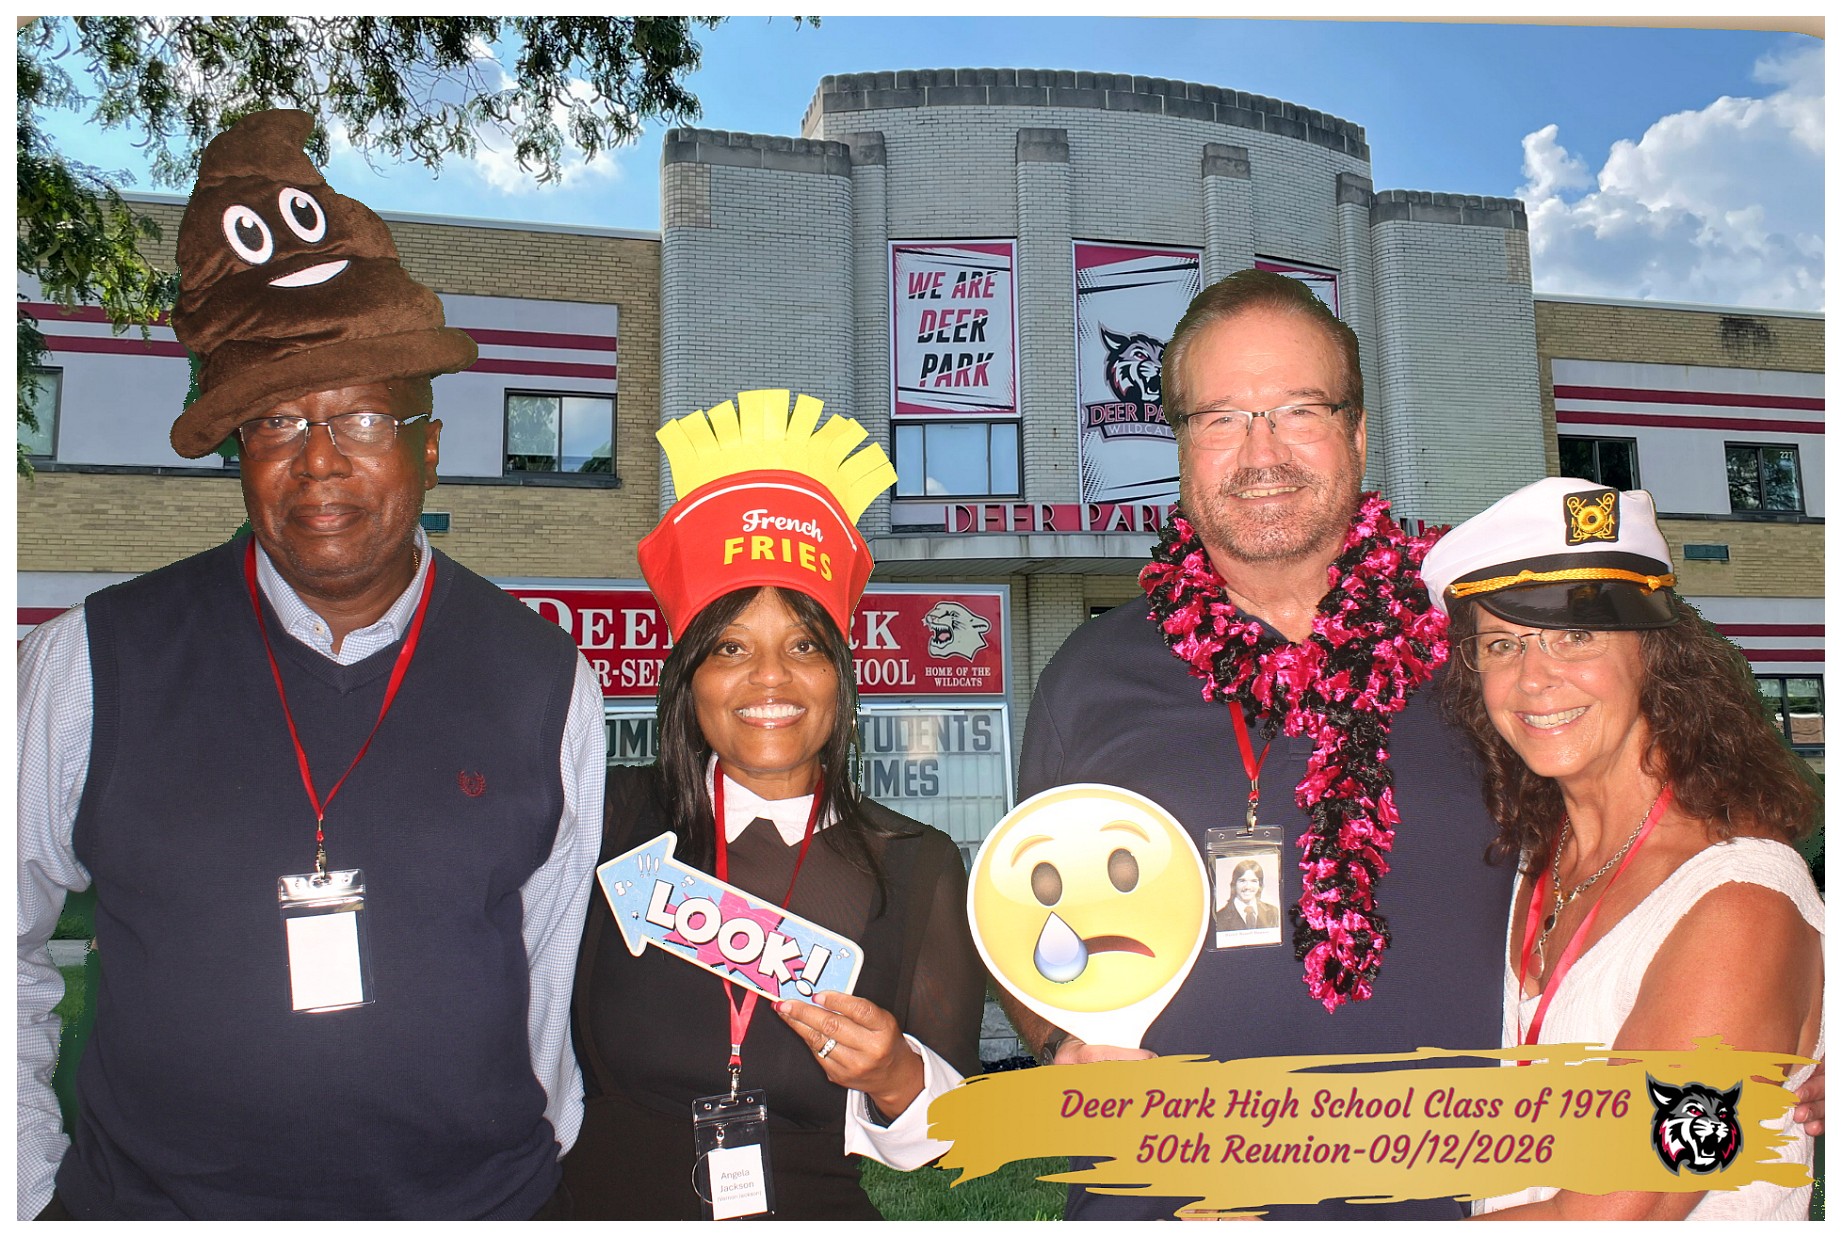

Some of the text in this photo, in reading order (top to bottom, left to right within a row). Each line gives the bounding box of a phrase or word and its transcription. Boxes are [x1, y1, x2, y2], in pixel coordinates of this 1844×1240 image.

[908, 271, 998, 299] WE ARE
[917, 309, 989, 344] DEER
[919, 352, 994, 387] PARK
[1089, 402, 1170, 425] DEER PA
[1108, 424, 1175, 437] WILDCAT
[1779, 451, 1793, 460] 227
[742, 508, 823, 542] French
[947, 503, 1058, 533] DEER
[723, 535, 833, 582] FRIES
[925, 667, 991, 677] HOME OF THE
[934, 677, 983, 687] WILDCATS
[858, 714, 992, 752] TUDENTS
[851, 759, 939, 797] UMES
[645, 879, 832, 997] LOOK!
[720, 1169, 750, 1180] Angela
[720, 1181, 755, 1193] Jackson
